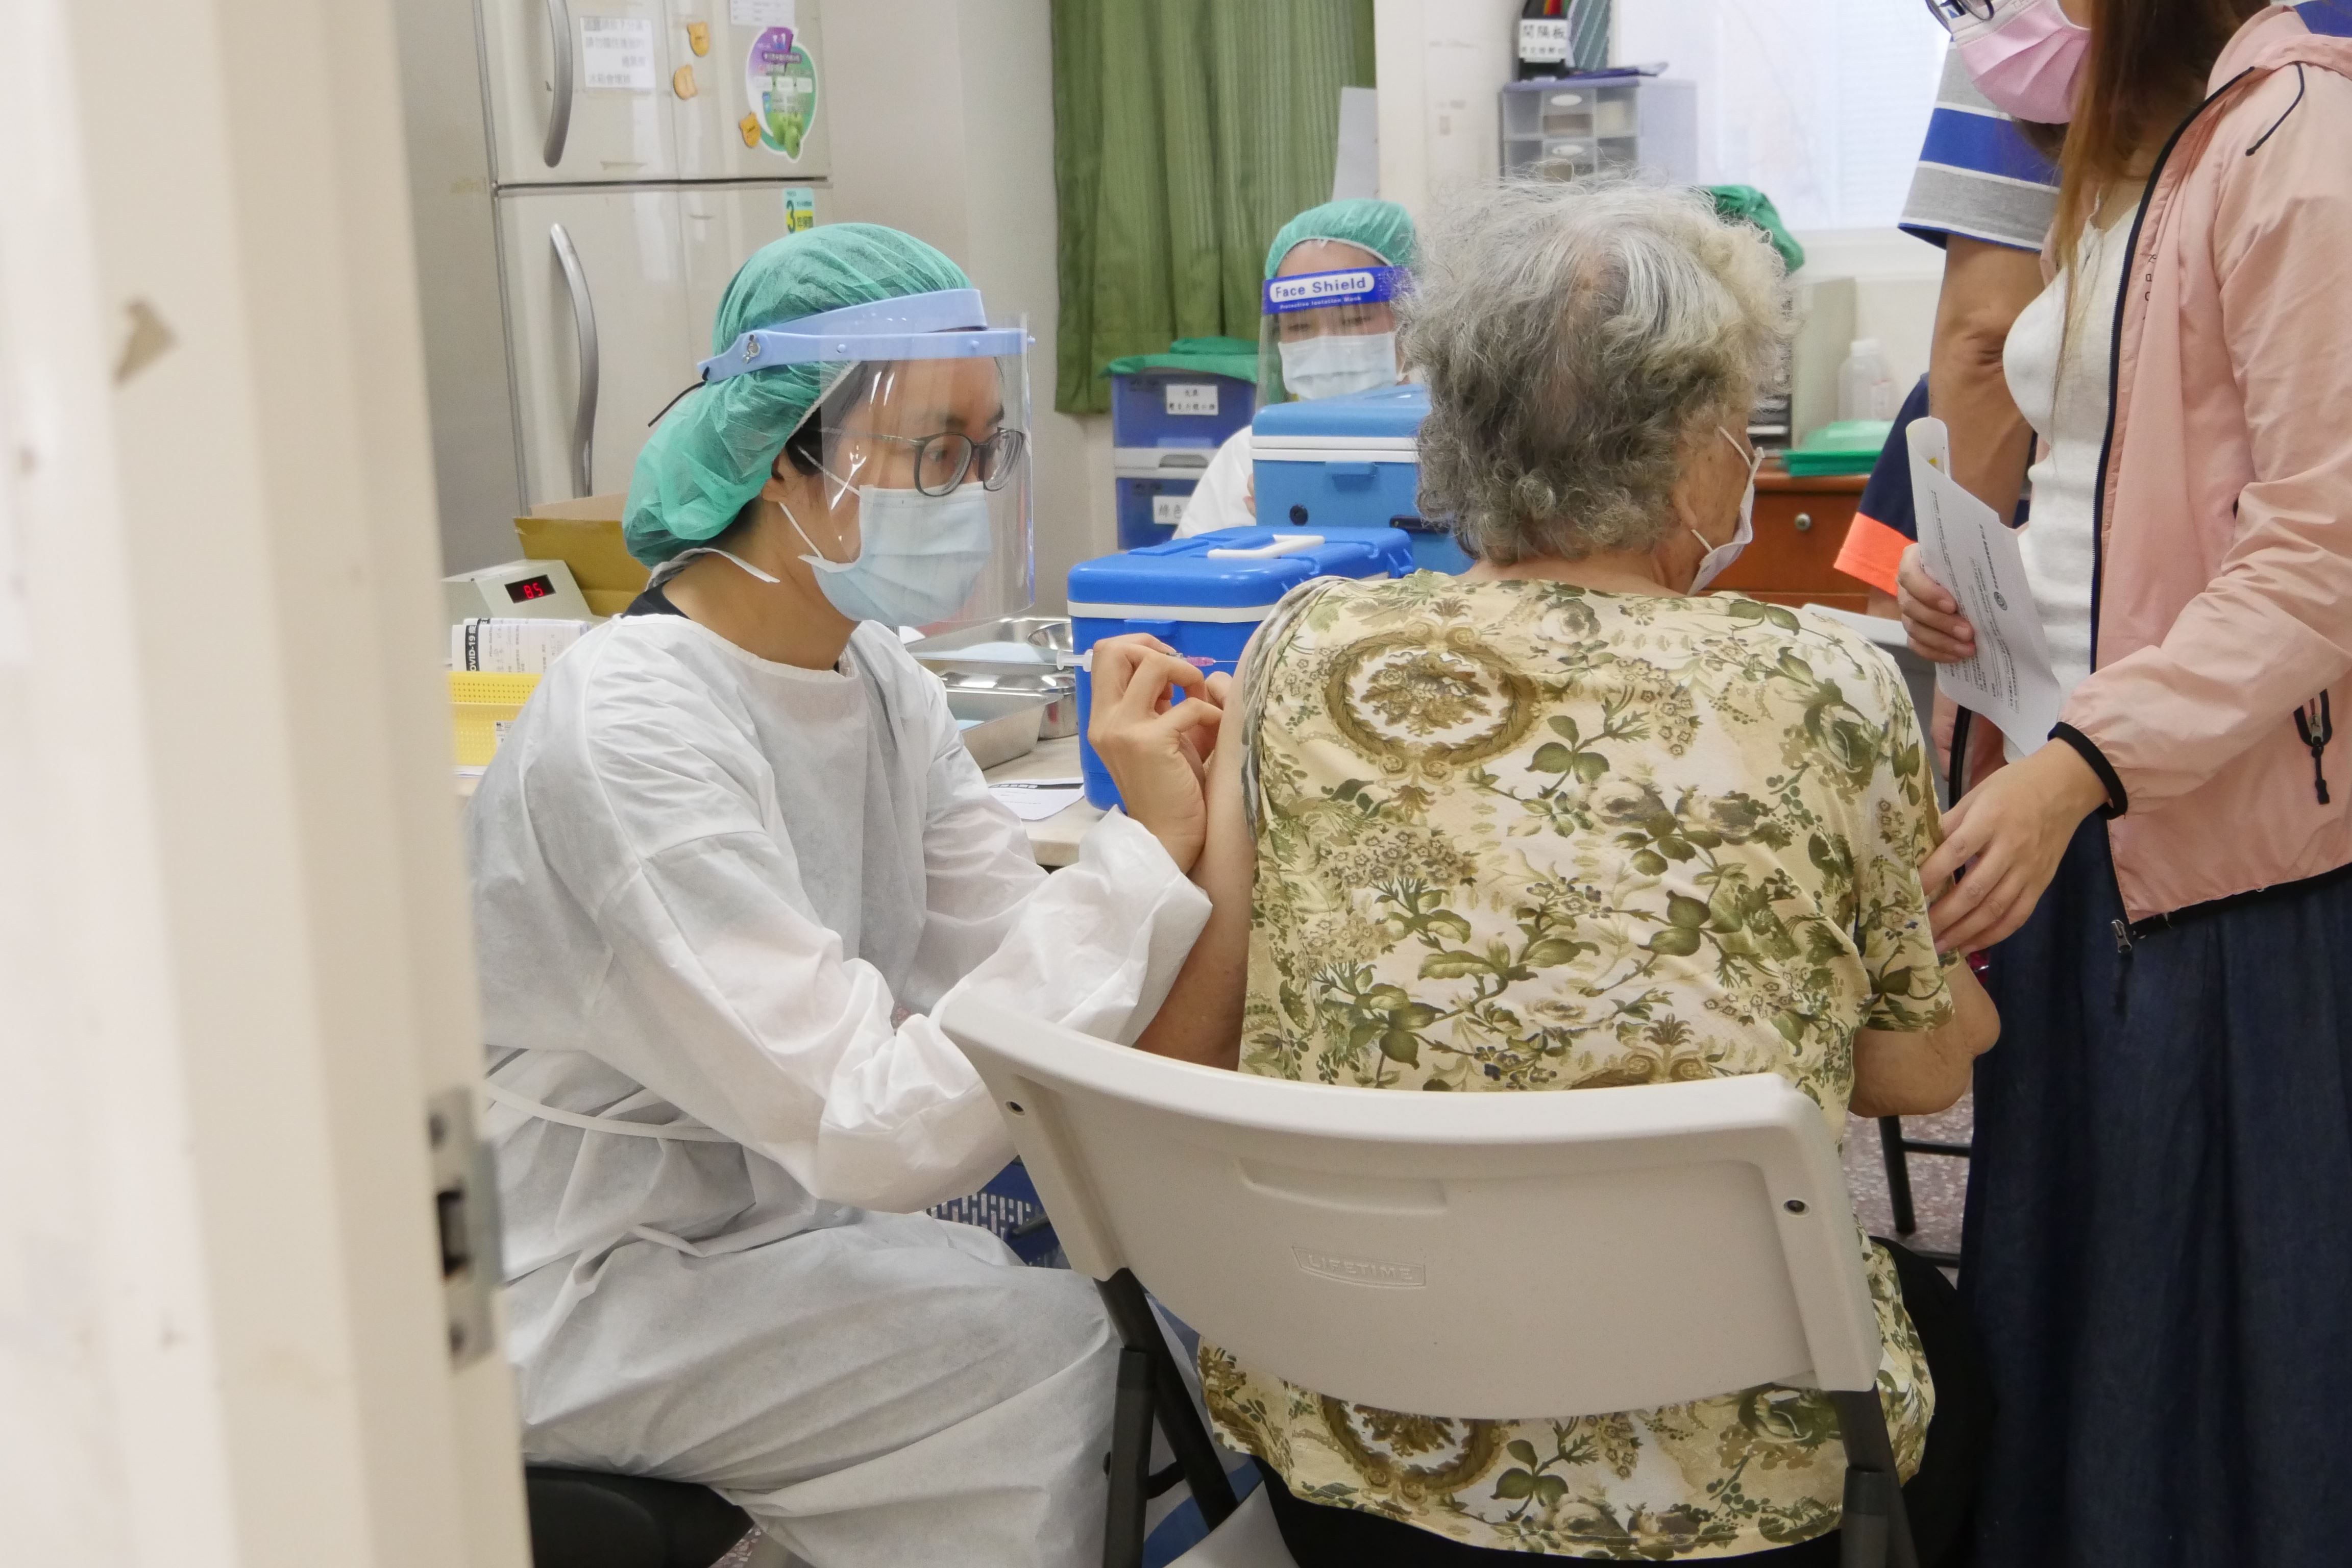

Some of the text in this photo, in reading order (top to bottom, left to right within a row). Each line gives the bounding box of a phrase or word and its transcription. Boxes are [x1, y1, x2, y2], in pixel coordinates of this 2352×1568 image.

[1276, 286, 1306, 298] Face
[1312, 277, 1366, 293] Shield
[523, 582, 544, 599] 85
[469, 635, 477, 671] OVID-19
[1308, 1254, 1413, 1280] LIFETIME
